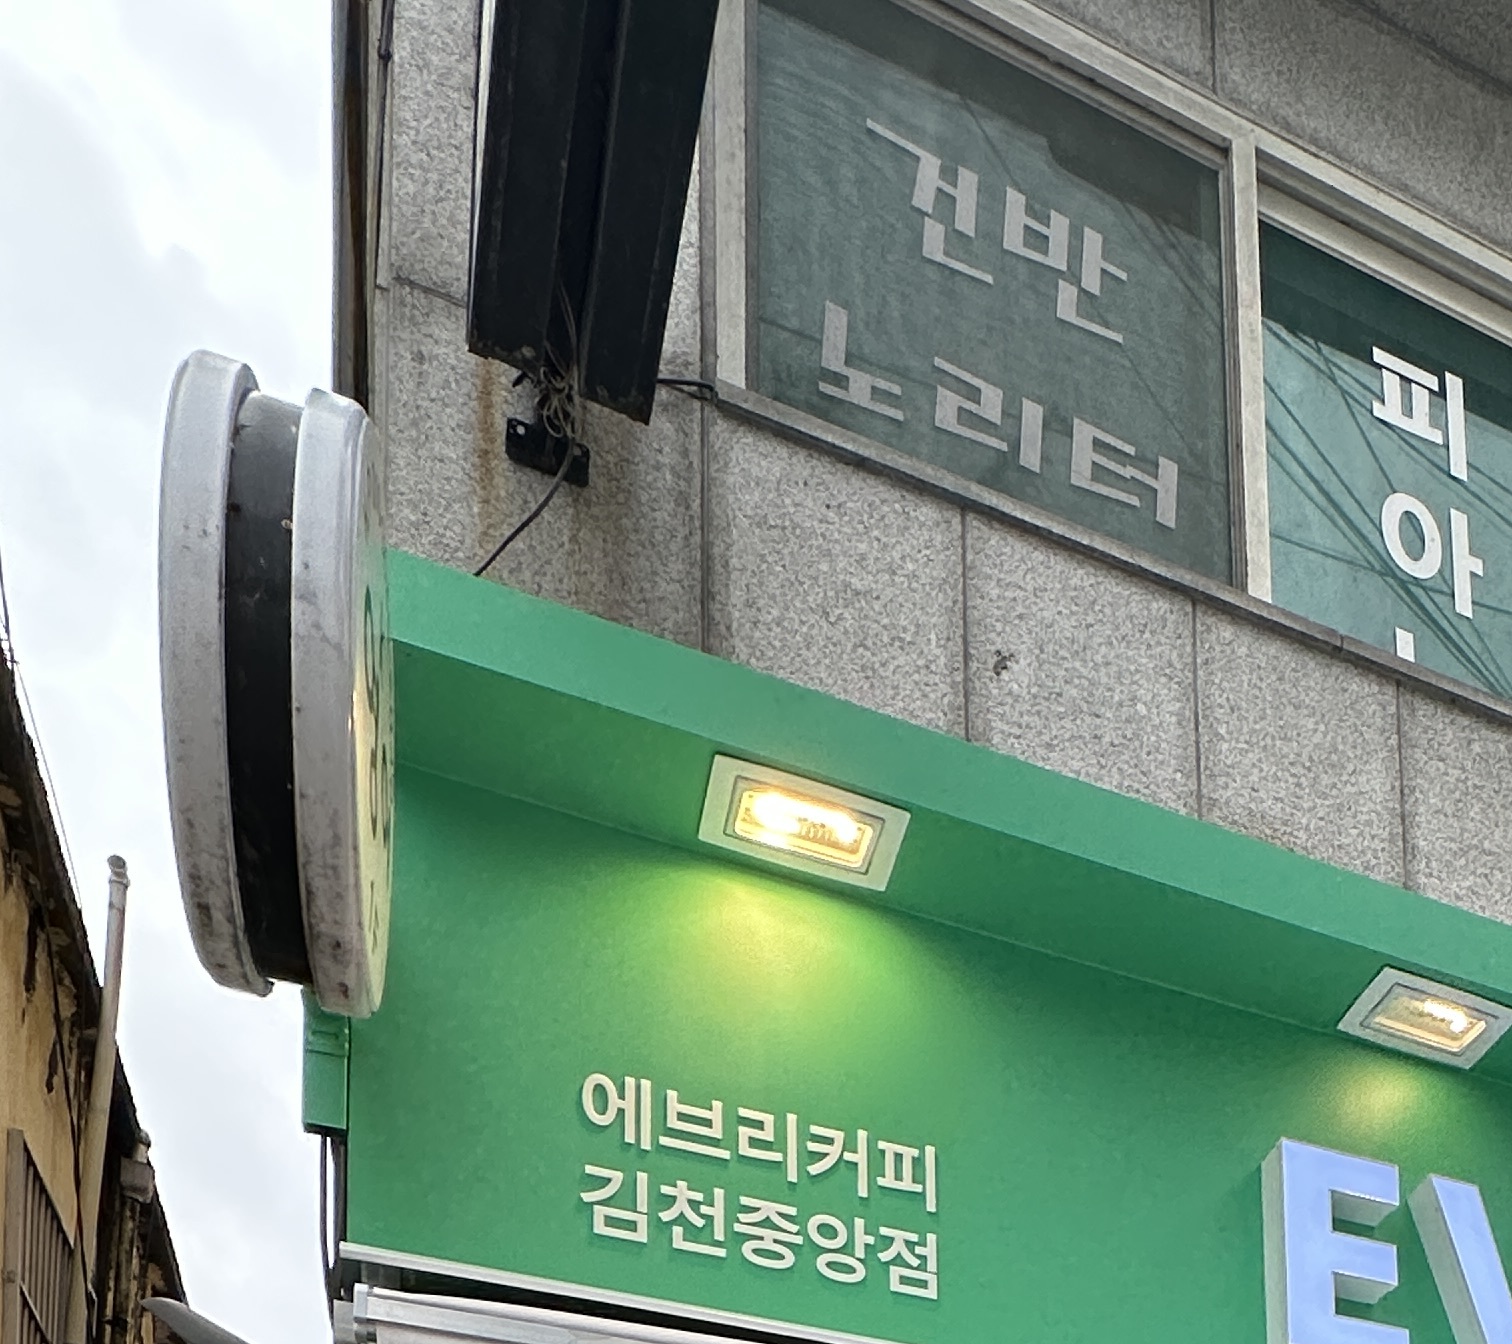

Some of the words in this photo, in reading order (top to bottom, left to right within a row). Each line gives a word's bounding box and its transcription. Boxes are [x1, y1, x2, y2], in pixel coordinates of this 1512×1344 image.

[866, 118, 1127, 344] 건반
[818, 301, 1178, 529] 노리터
[1372, 346, 1484, 663] 피아
[580, 1164, 939, 1300] 김천중앙점
[581, 1072, 938, 1214] 에브리커피
